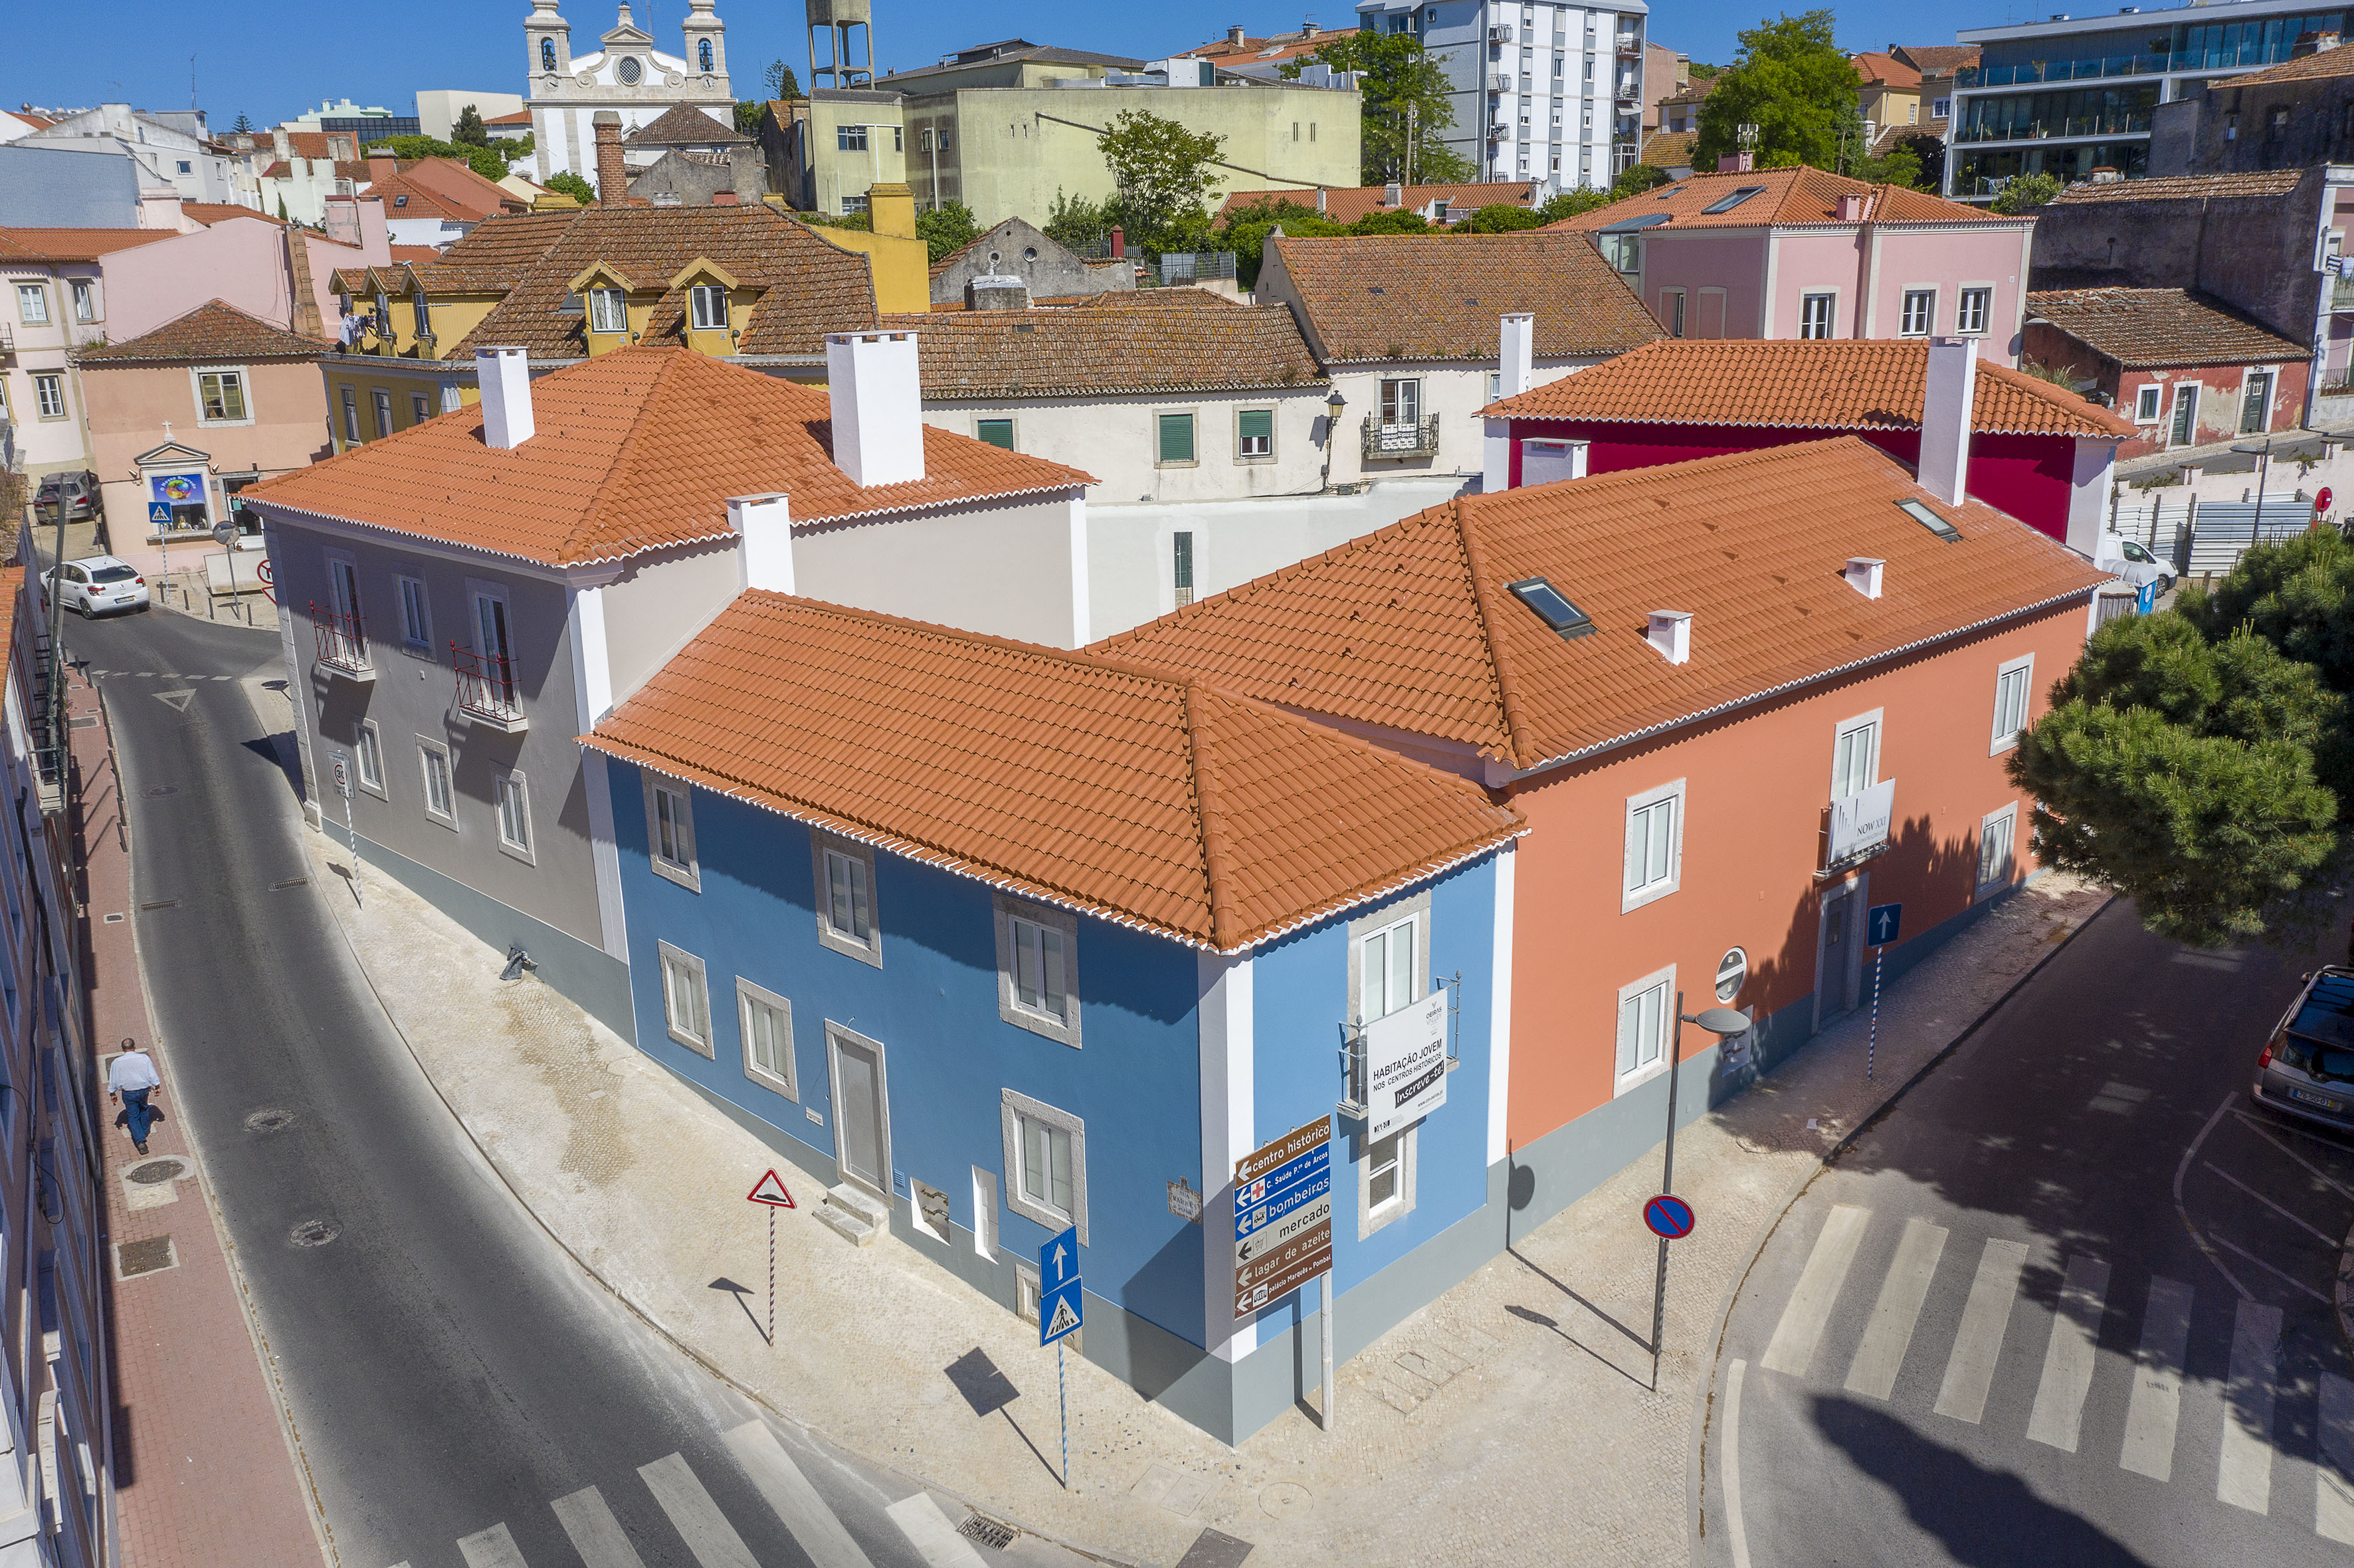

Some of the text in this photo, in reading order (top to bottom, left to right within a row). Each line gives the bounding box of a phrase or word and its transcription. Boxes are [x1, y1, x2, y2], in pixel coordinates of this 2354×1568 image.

[1857, 816, 1886, 836] NOW XXI
[1426, 1006, 1442, 1019] OEIRAS
[1373, 1038, 1442, 1081] HABITAÇÃO JOVEM
[1373, 1052, 1442, 1092] NOS CENTROS HISTÓRICOS
[1397, 1062, 1444, 1104] Inscreve-te!
[1252, 1125, 1329, 1172] centro histórico
[1275, 1171, 1292, 1185] Saúde
[1313, 1151, 1328, 1164] Arcos
[1270, 1177, 1329, 1217] bombeiros
[1280, 1204, 1329, 1238] mercado
[1255, 1229, 1330, 1277] lagar de azeite
[1268, 1279, 1286, 1294] palácio
[1287, 1267, 1308, 1282] Marquês
[1313, 1254, 1331, 1268] Pombal
